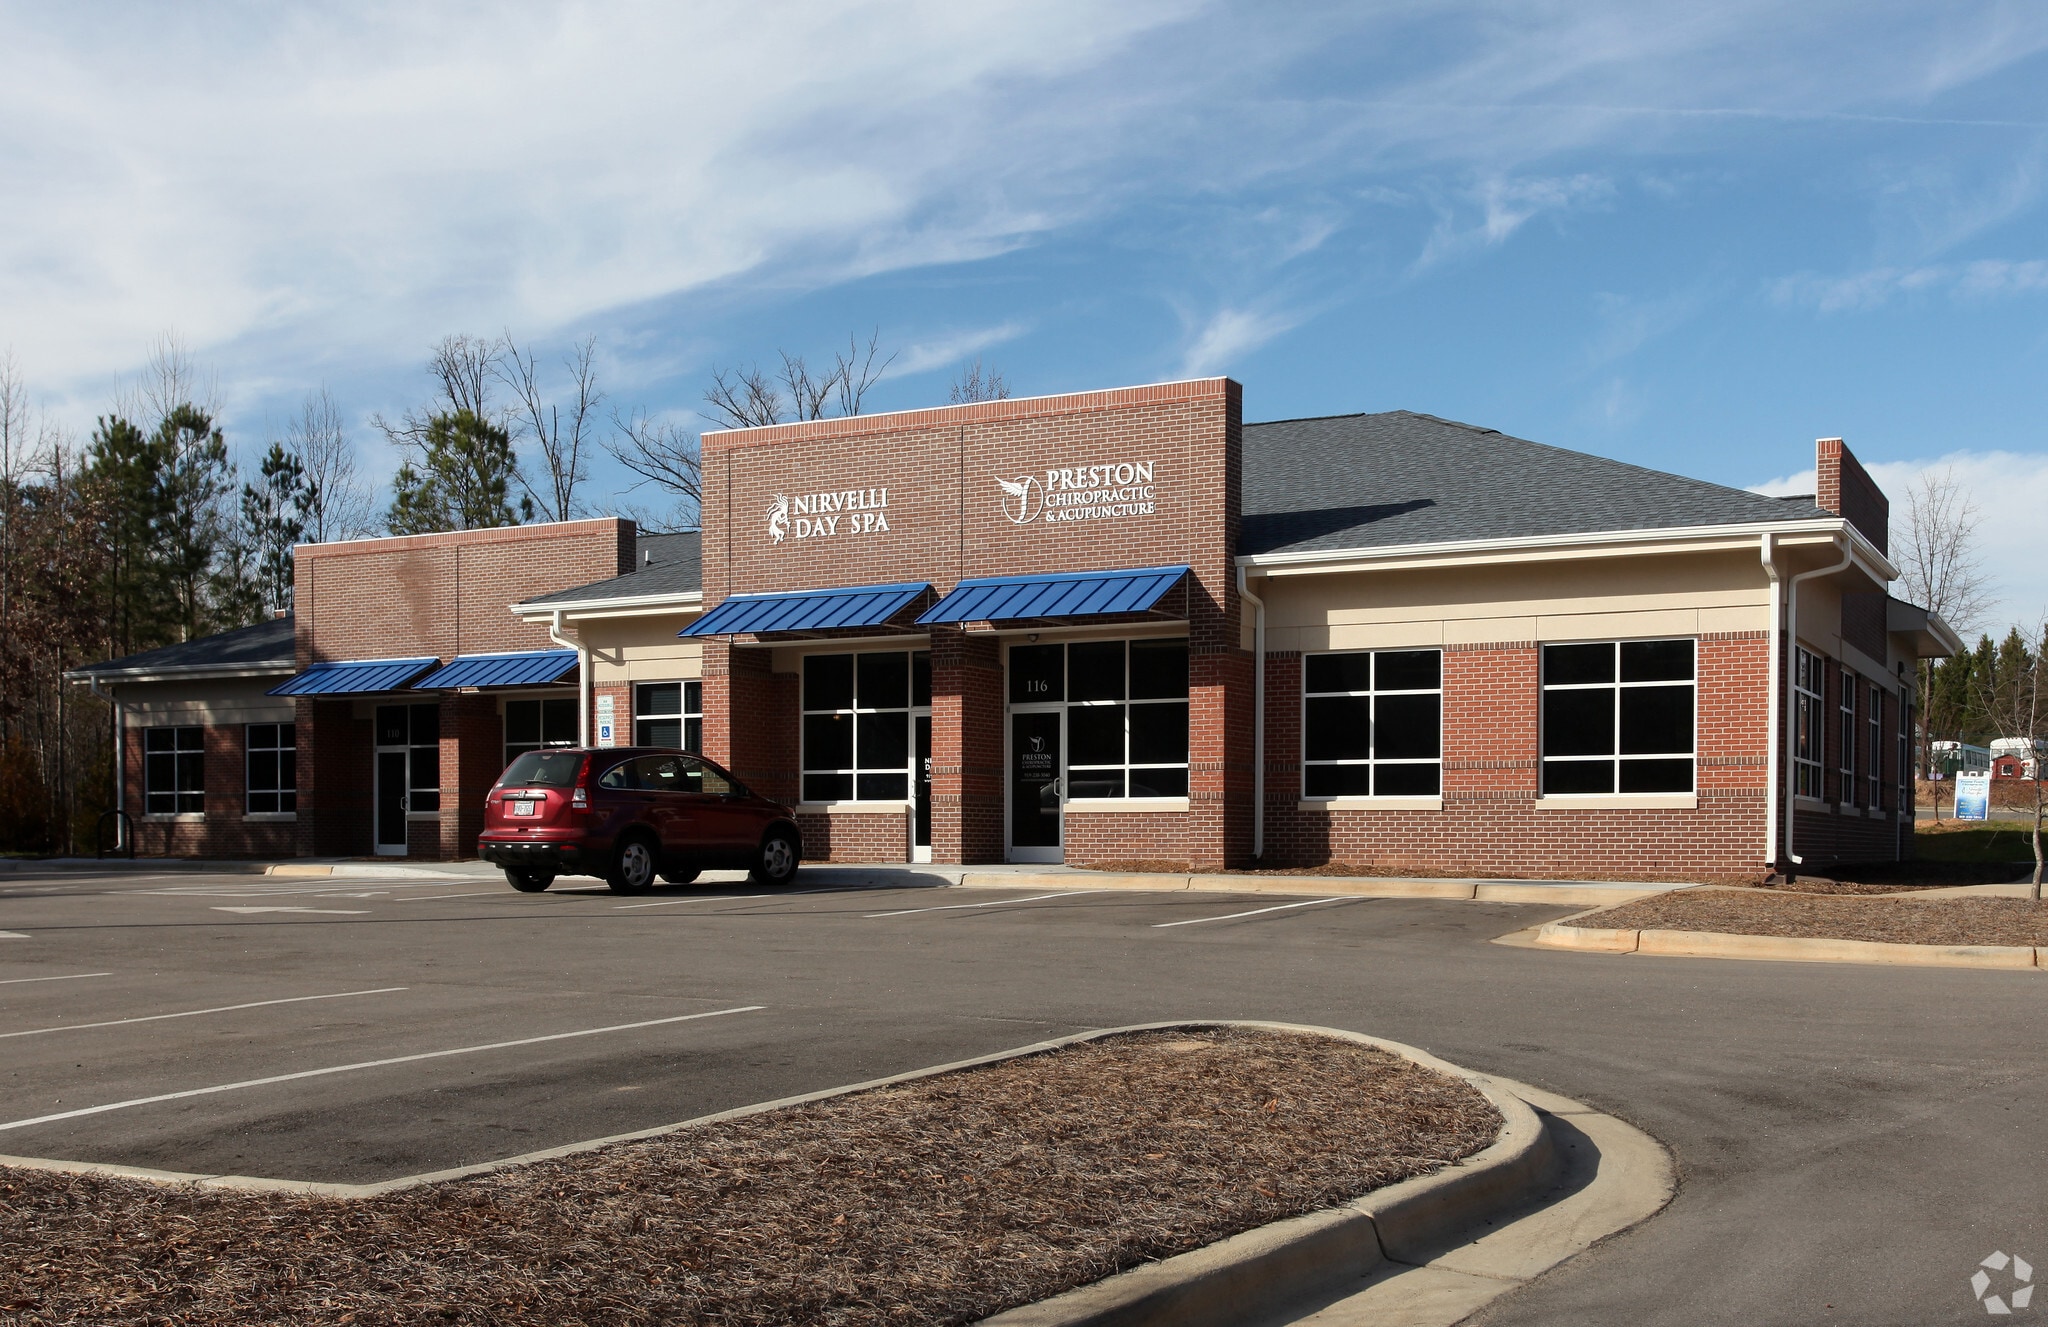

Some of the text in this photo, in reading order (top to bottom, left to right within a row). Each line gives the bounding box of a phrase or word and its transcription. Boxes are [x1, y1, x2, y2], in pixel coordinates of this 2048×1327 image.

[1046, 461, 1155, 491] PRESTON
[793, 487, 889, 515] NIRVELLI
[1045, 485, 1155, 507] CHIROPRACTIC
[1045, 502, 1155, 522] & ACUPUNCTURE
[794, 511, 890, 539] DAY SPA
[1027, 679, 1048, 692] 116
[1022, 753, 1052, 761] PRESTON
